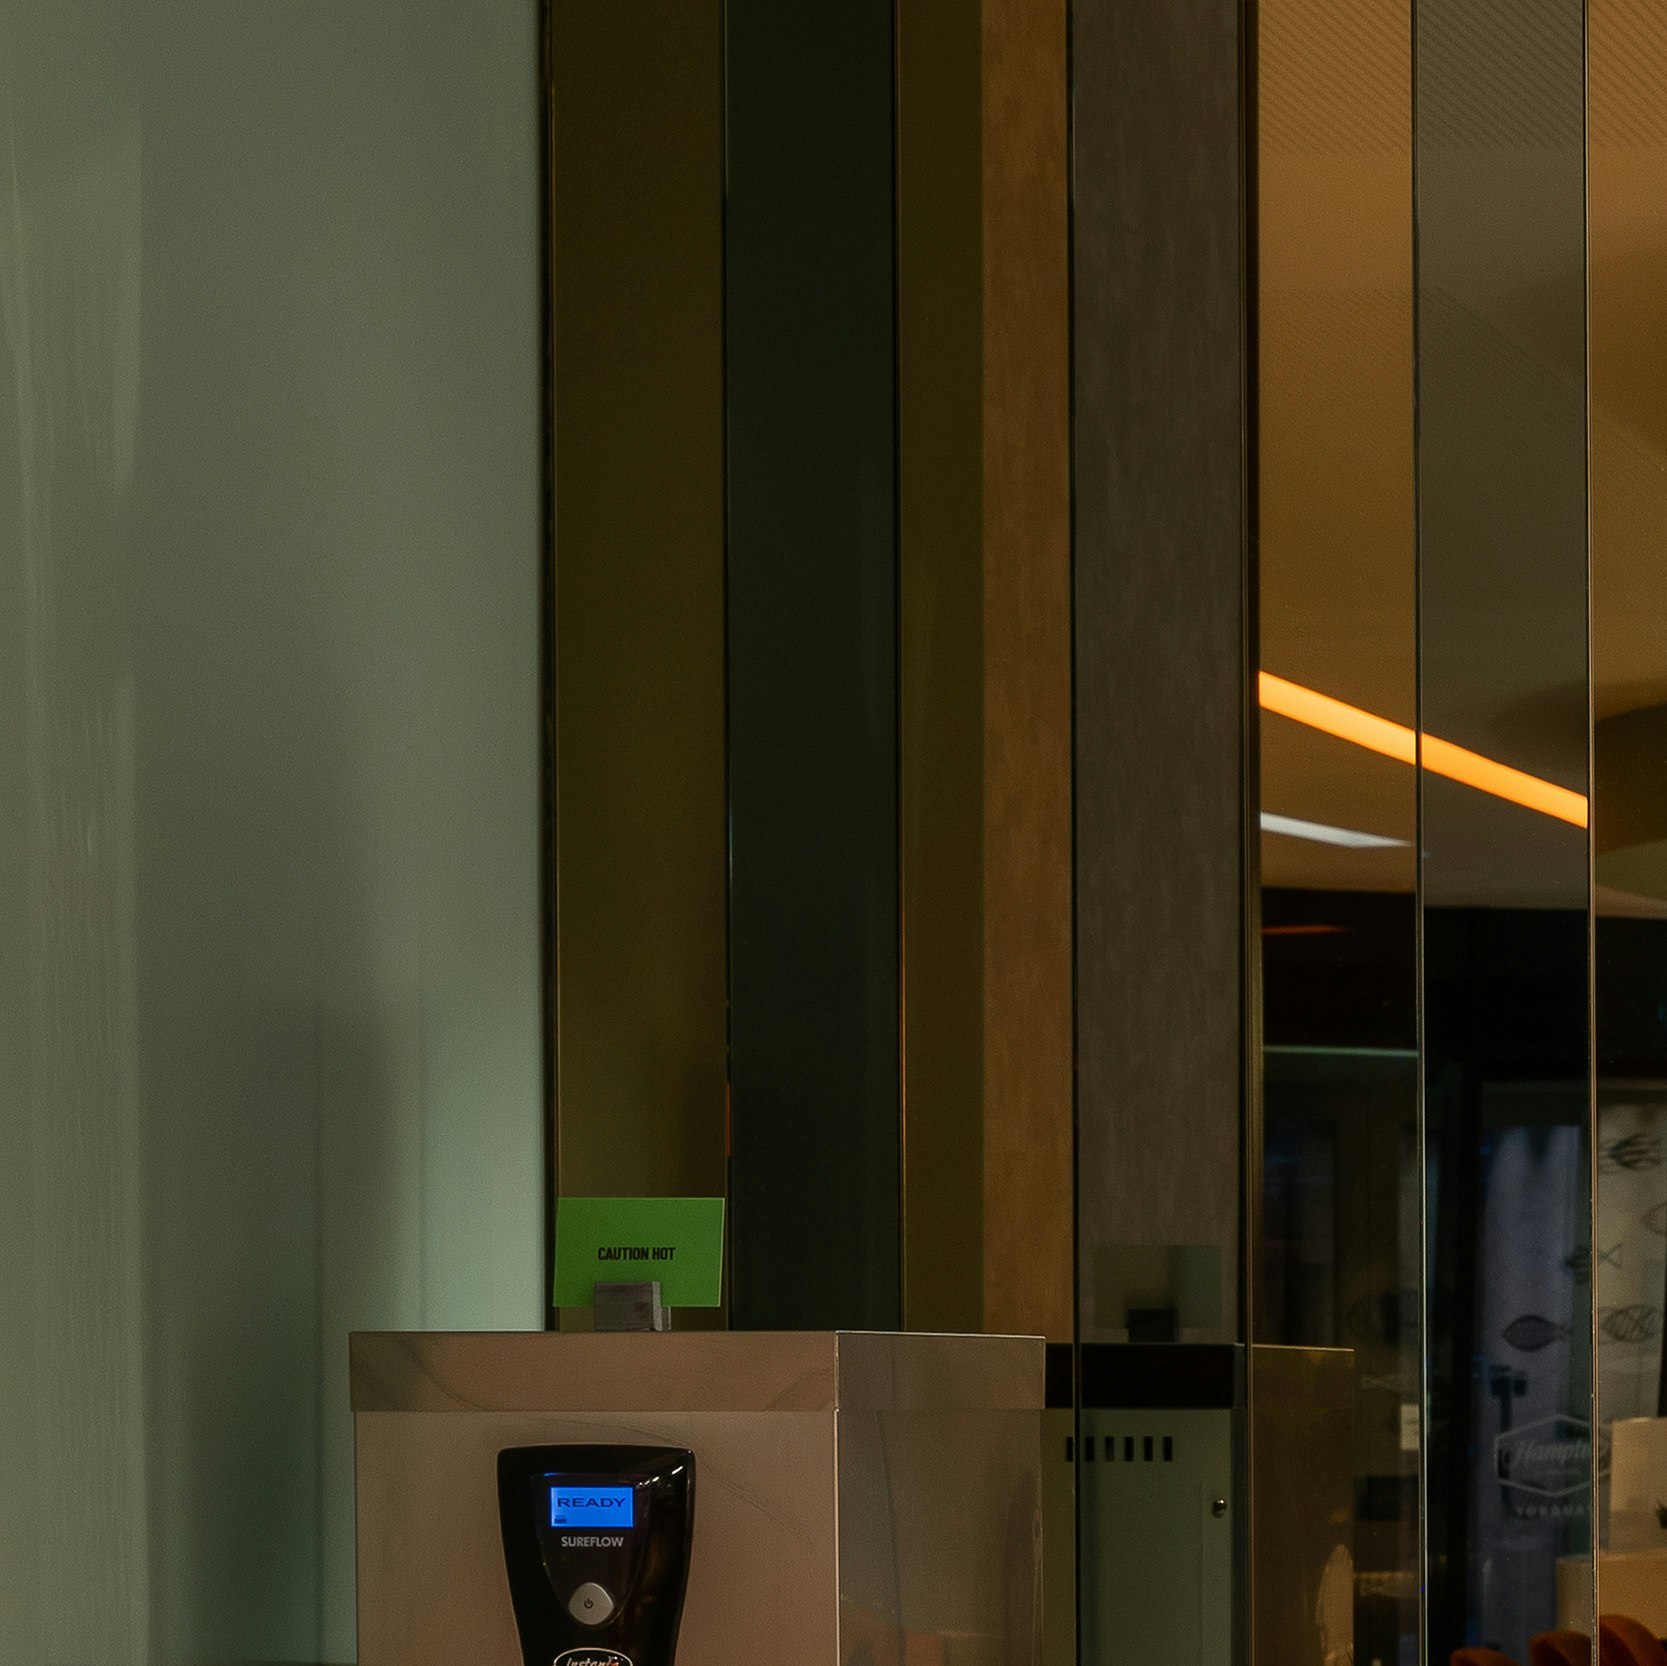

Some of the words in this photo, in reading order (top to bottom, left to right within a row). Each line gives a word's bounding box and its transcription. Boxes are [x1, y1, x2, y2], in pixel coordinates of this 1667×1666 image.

[598, 1247, 649, 1260] CAUTION
[652, 1247, 676, 1260] HOT
[557, 1497, 627, 1508] READY
[561, 1536, 624, 1548] SUREFLOW
